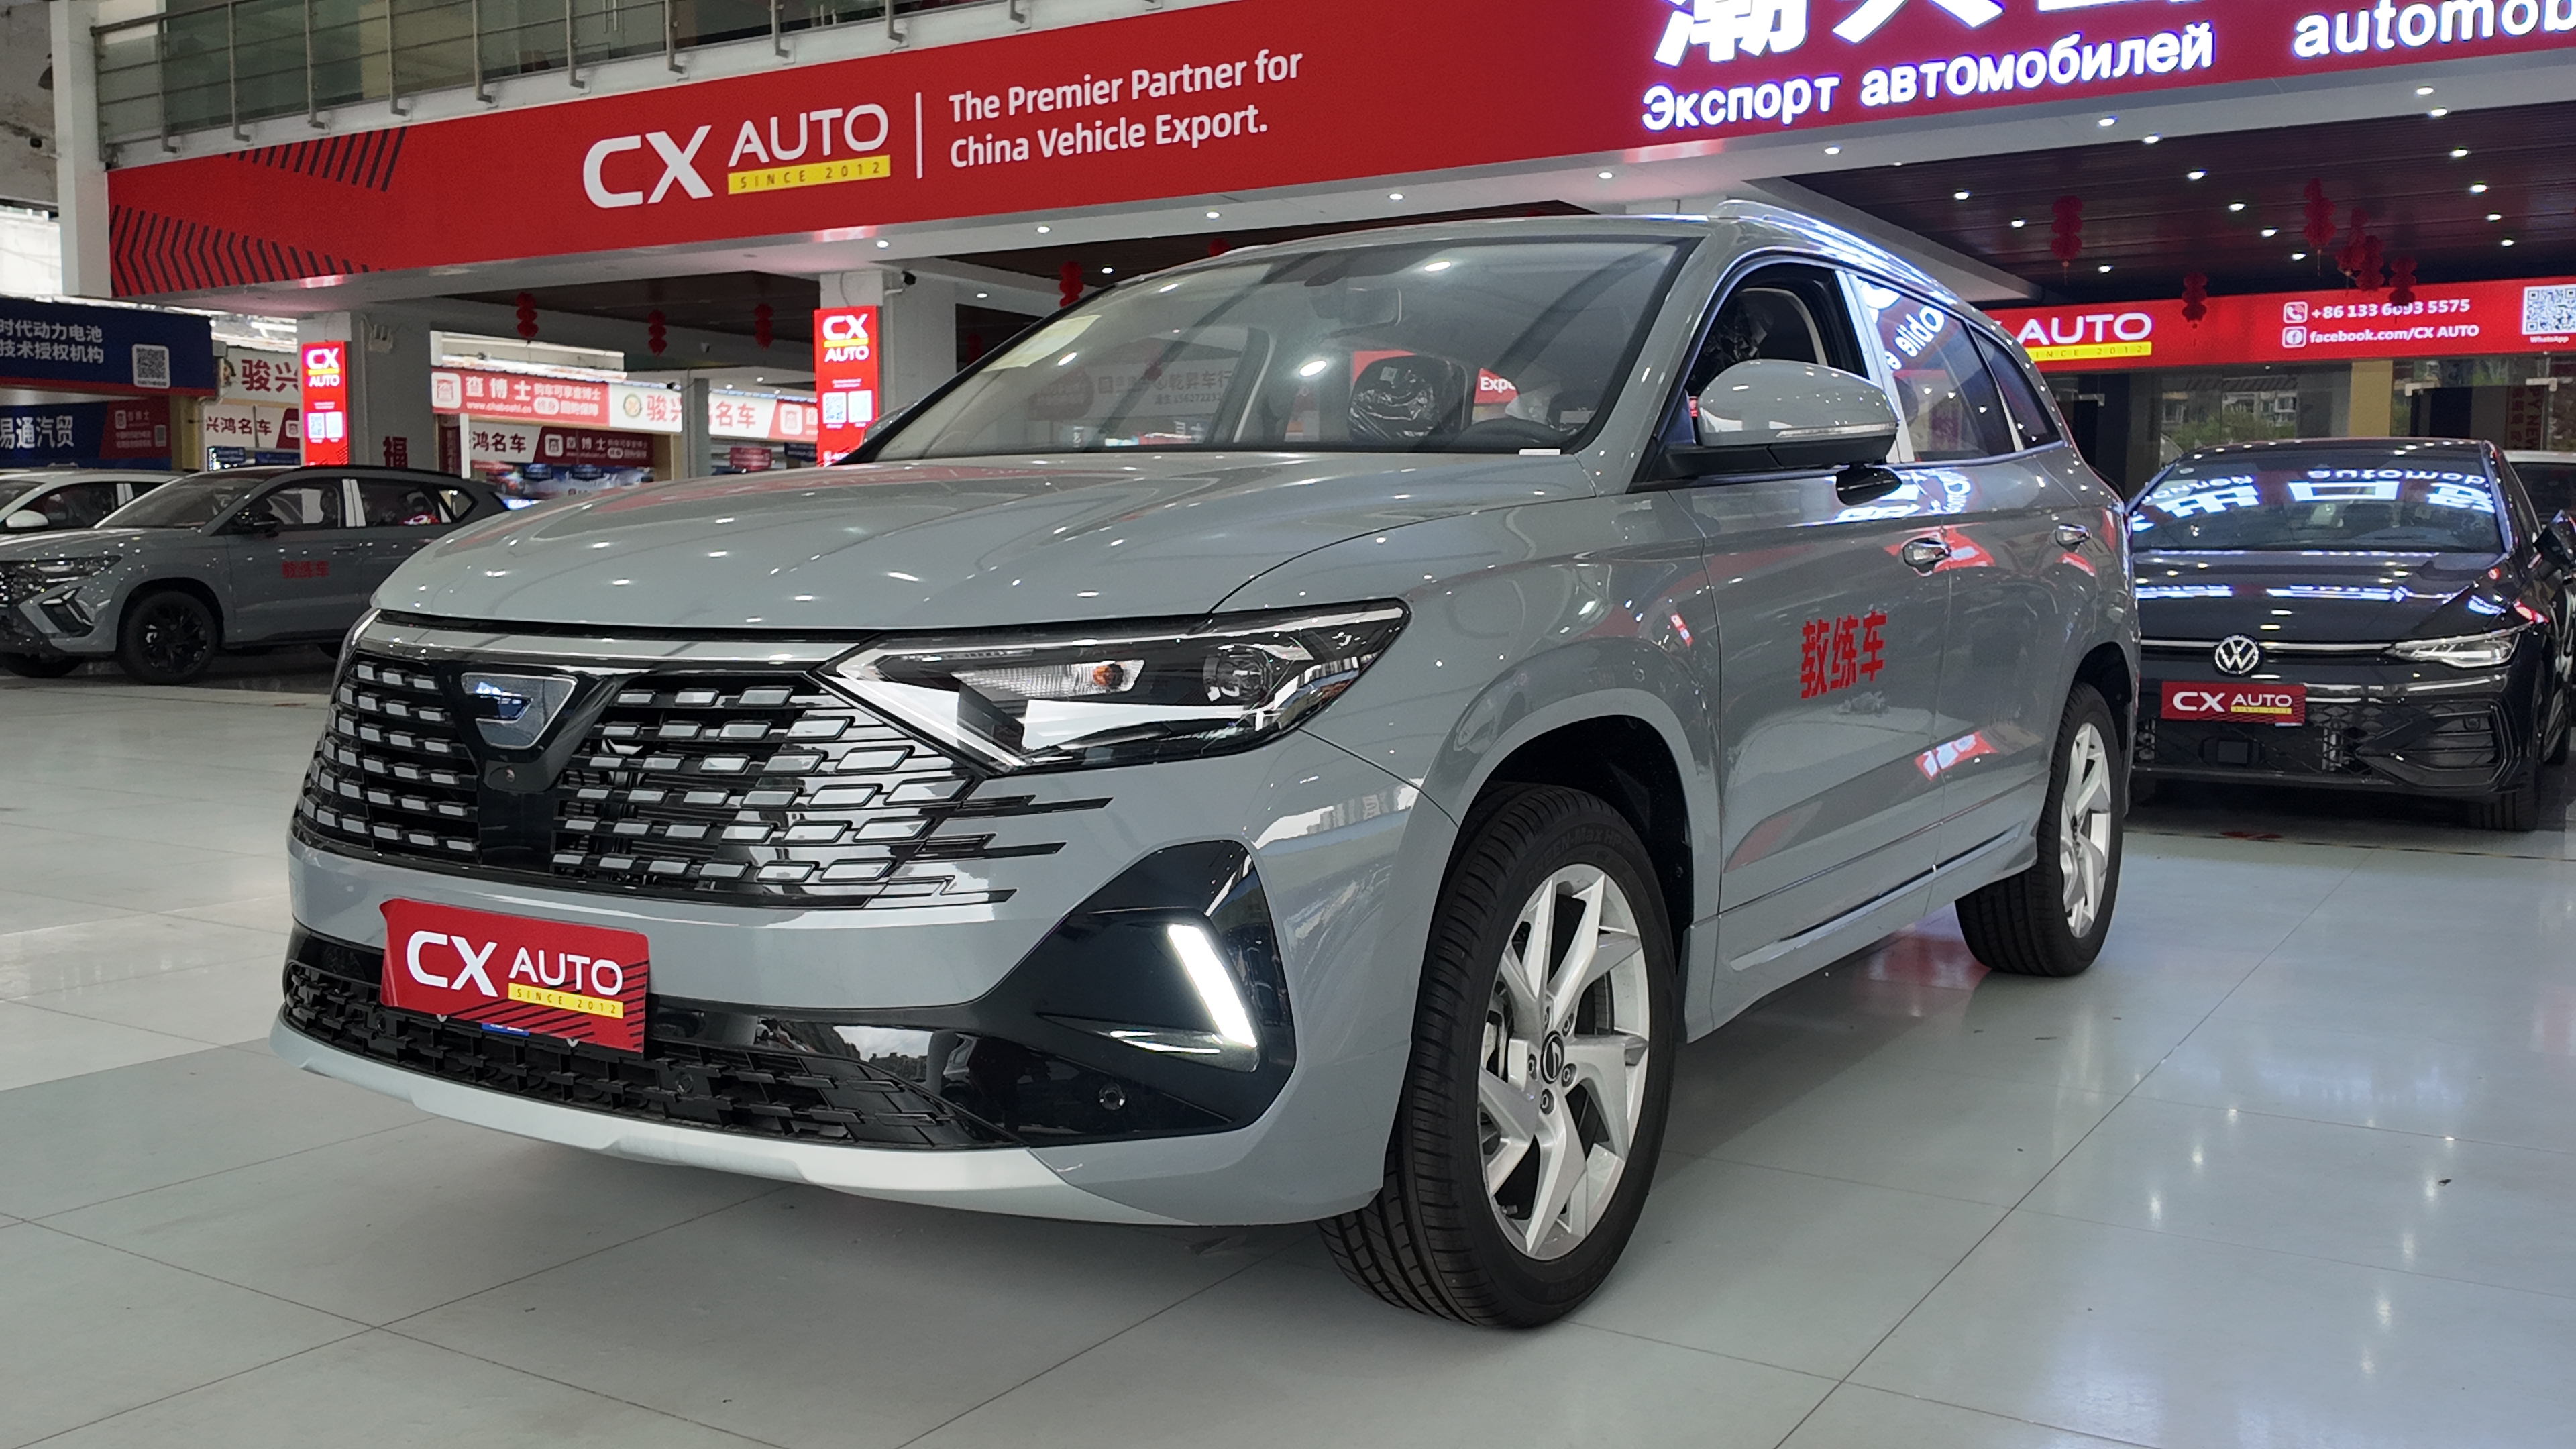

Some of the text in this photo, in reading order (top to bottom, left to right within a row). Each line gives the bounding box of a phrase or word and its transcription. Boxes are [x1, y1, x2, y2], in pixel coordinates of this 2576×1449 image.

[949, 48, 1303, 122] The Premier Partner for
[1642, 76, 1841, 131] Экспорт
[1860, 21, 2214, 107] автомобилей
[950, 104, 1268, 168] China Vehicle Export.
[582, 103, 889, 209] CX AUTO
[740, 161, 881, 189] SINCE 2012
[2311, 305, 2344, 319] +86
[2347, 304, 2378, 317] 133
[2428, 299, 2471, 314] 5575
[0, 319, 103, 343] 时代动力电池
[822, 313, 869, 340] CX
[2017, 313, 2152, 345] AUTO
[2310, 325, 2480, 343] facebook.com/CX AUTO
[0, 339, 104, 364] 技术授权机构
[307, 347, 339, 370] CX
[824, 345, 869, 363] AUTO
[2035, 345, 2143, 359] INCE 2012
[309, 374, 340, 388] AUTO
[708, 400, 756, 429] 名车
[0, 415, 74, 449] 易通汽贸
[383, 436, 408, 468] 福
[1799, 610, 1888, 700] 教练车
[2173, 691, 2292, 712] CX AUTO
[406, 930, 623, 998] CX AUTO
[517, 988, 616, 1014] SINCE 2012
